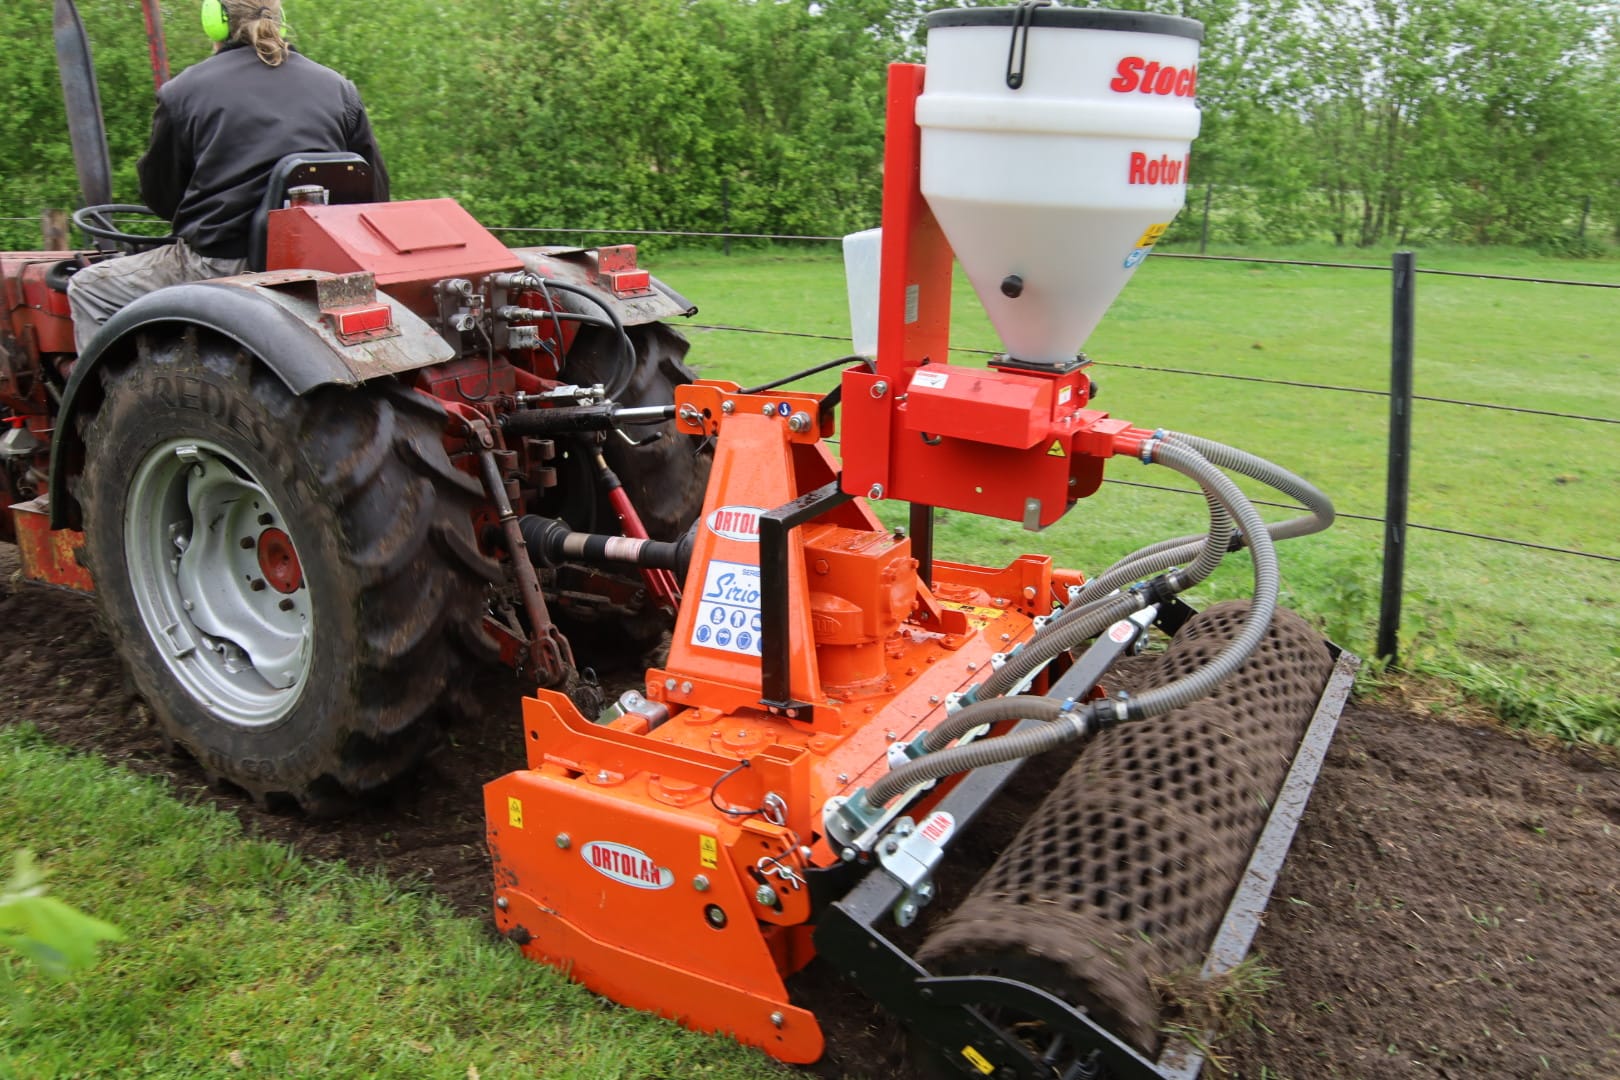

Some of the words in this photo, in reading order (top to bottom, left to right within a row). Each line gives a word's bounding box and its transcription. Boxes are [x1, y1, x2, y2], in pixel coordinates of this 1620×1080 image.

[1129, 152, 1182, 185] Rotor
[715, 511, 760, 534] ORTOL
[706, 573, 760, 603] Sirio
[592, 845, 660, 885] ORTOLAN
